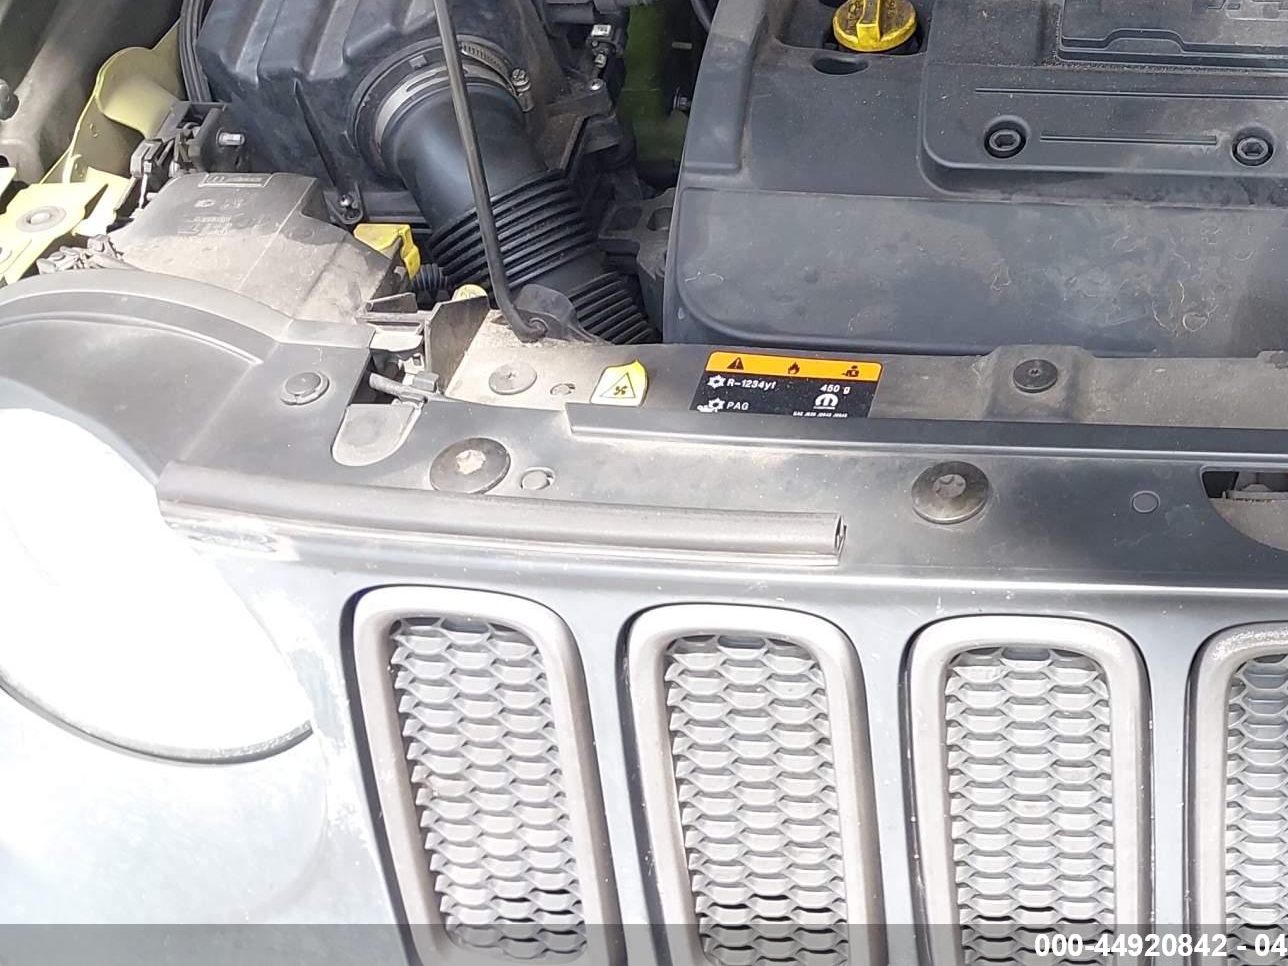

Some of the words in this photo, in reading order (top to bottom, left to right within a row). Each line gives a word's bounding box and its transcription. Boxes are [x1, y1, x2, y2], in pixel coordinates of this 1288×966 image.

[726, 378, 777, 391] R-1234yf
[819, 383, 841, 393] 450
[726, 401, 750, 411] PAG
